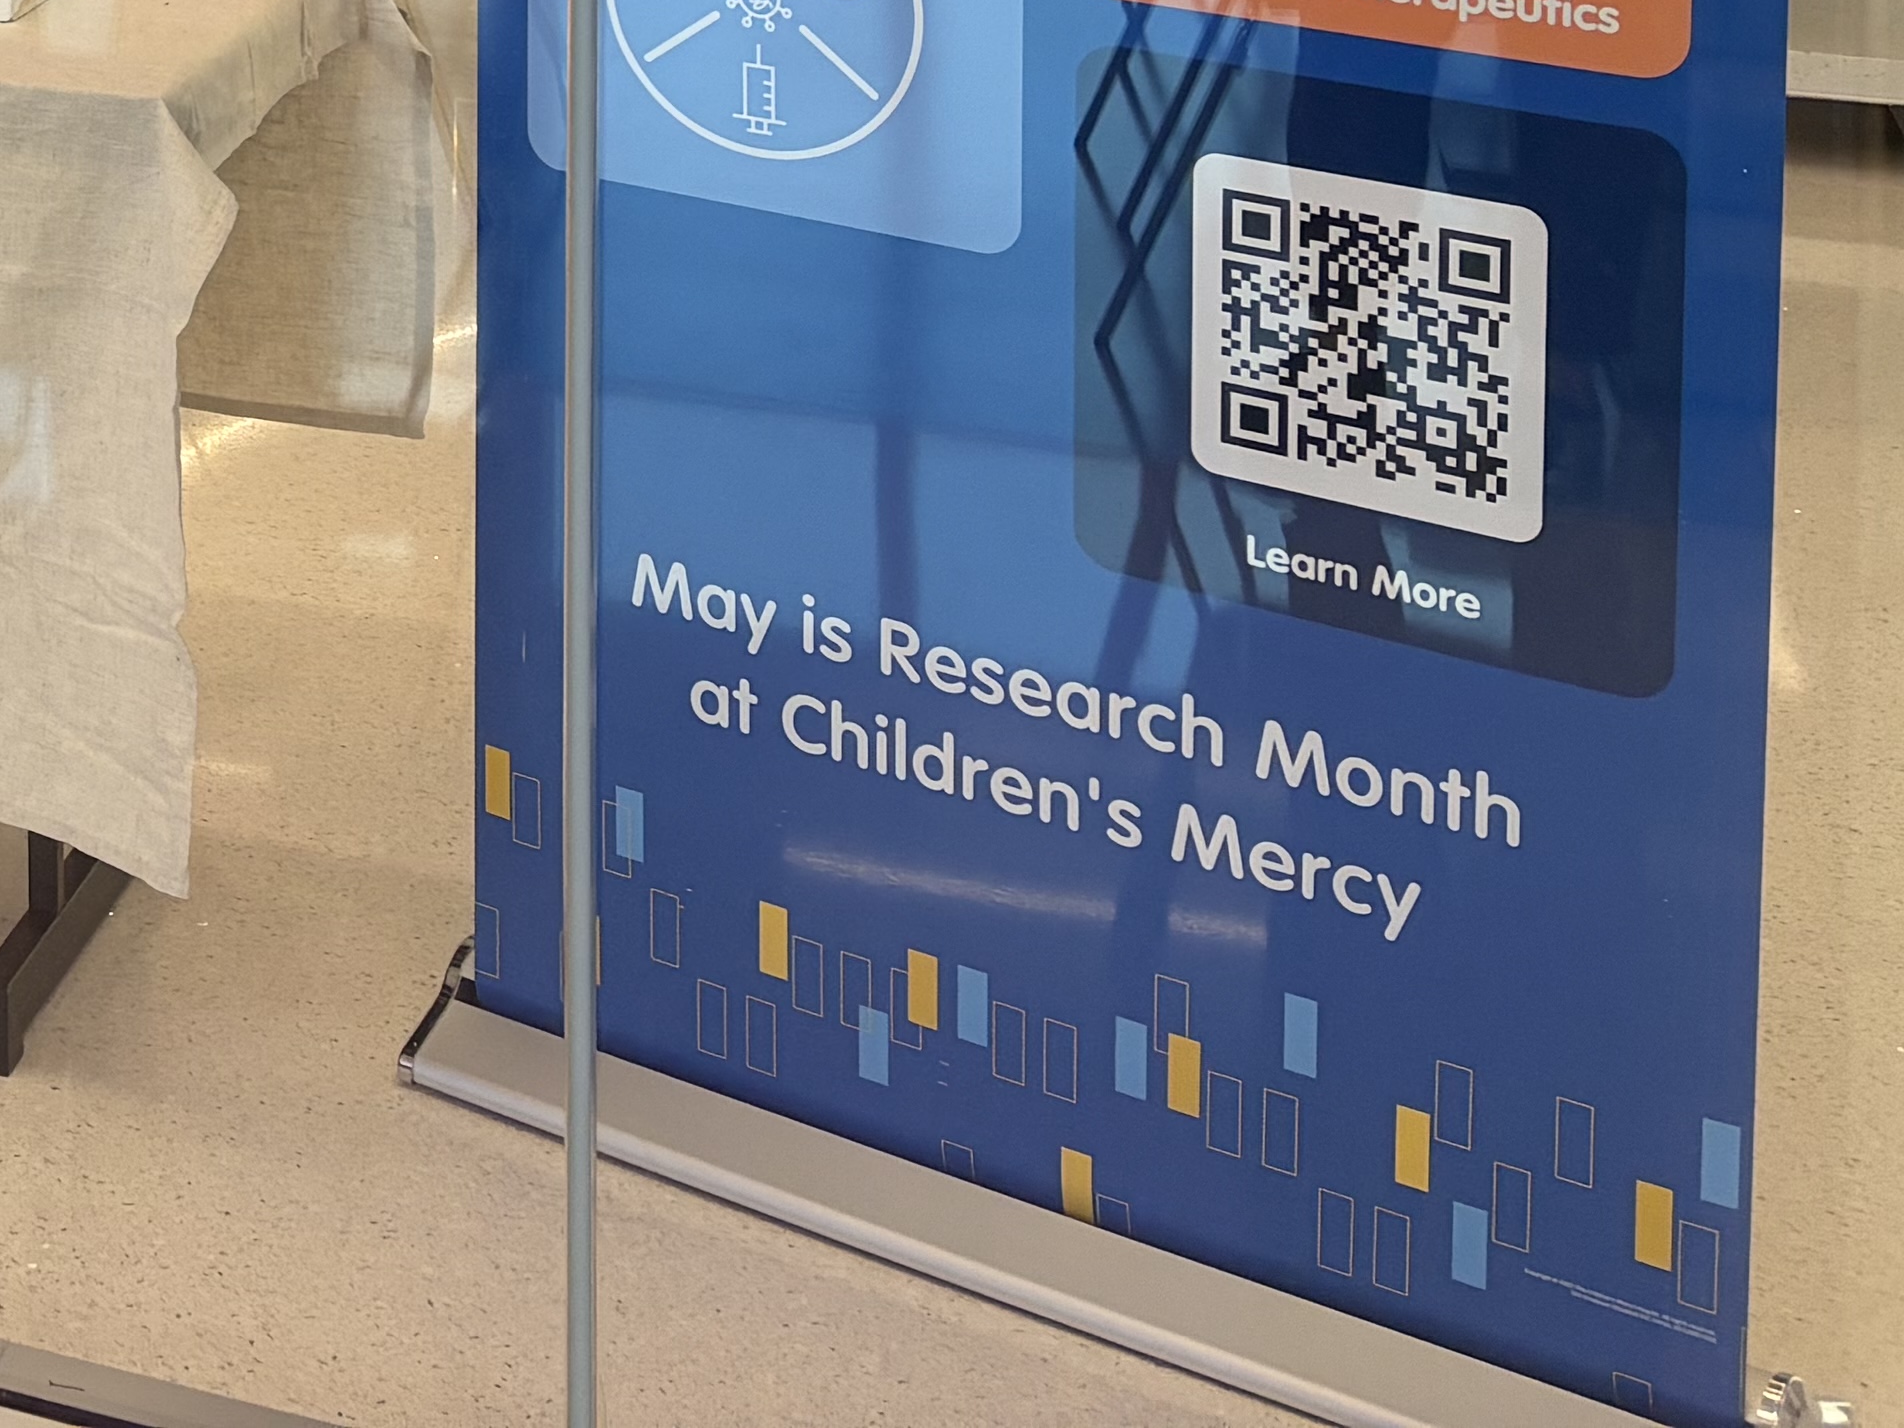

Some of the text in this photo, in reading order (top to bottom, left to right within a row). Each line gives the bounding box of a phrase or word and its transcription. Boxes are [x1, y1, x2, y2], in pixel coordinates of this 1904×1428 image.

[631, 553, 1521, 848] May is Research Month
[1245, 534, 1482, 619] Learn More
[690, 680, 1423, 941] at Children's Mercy
